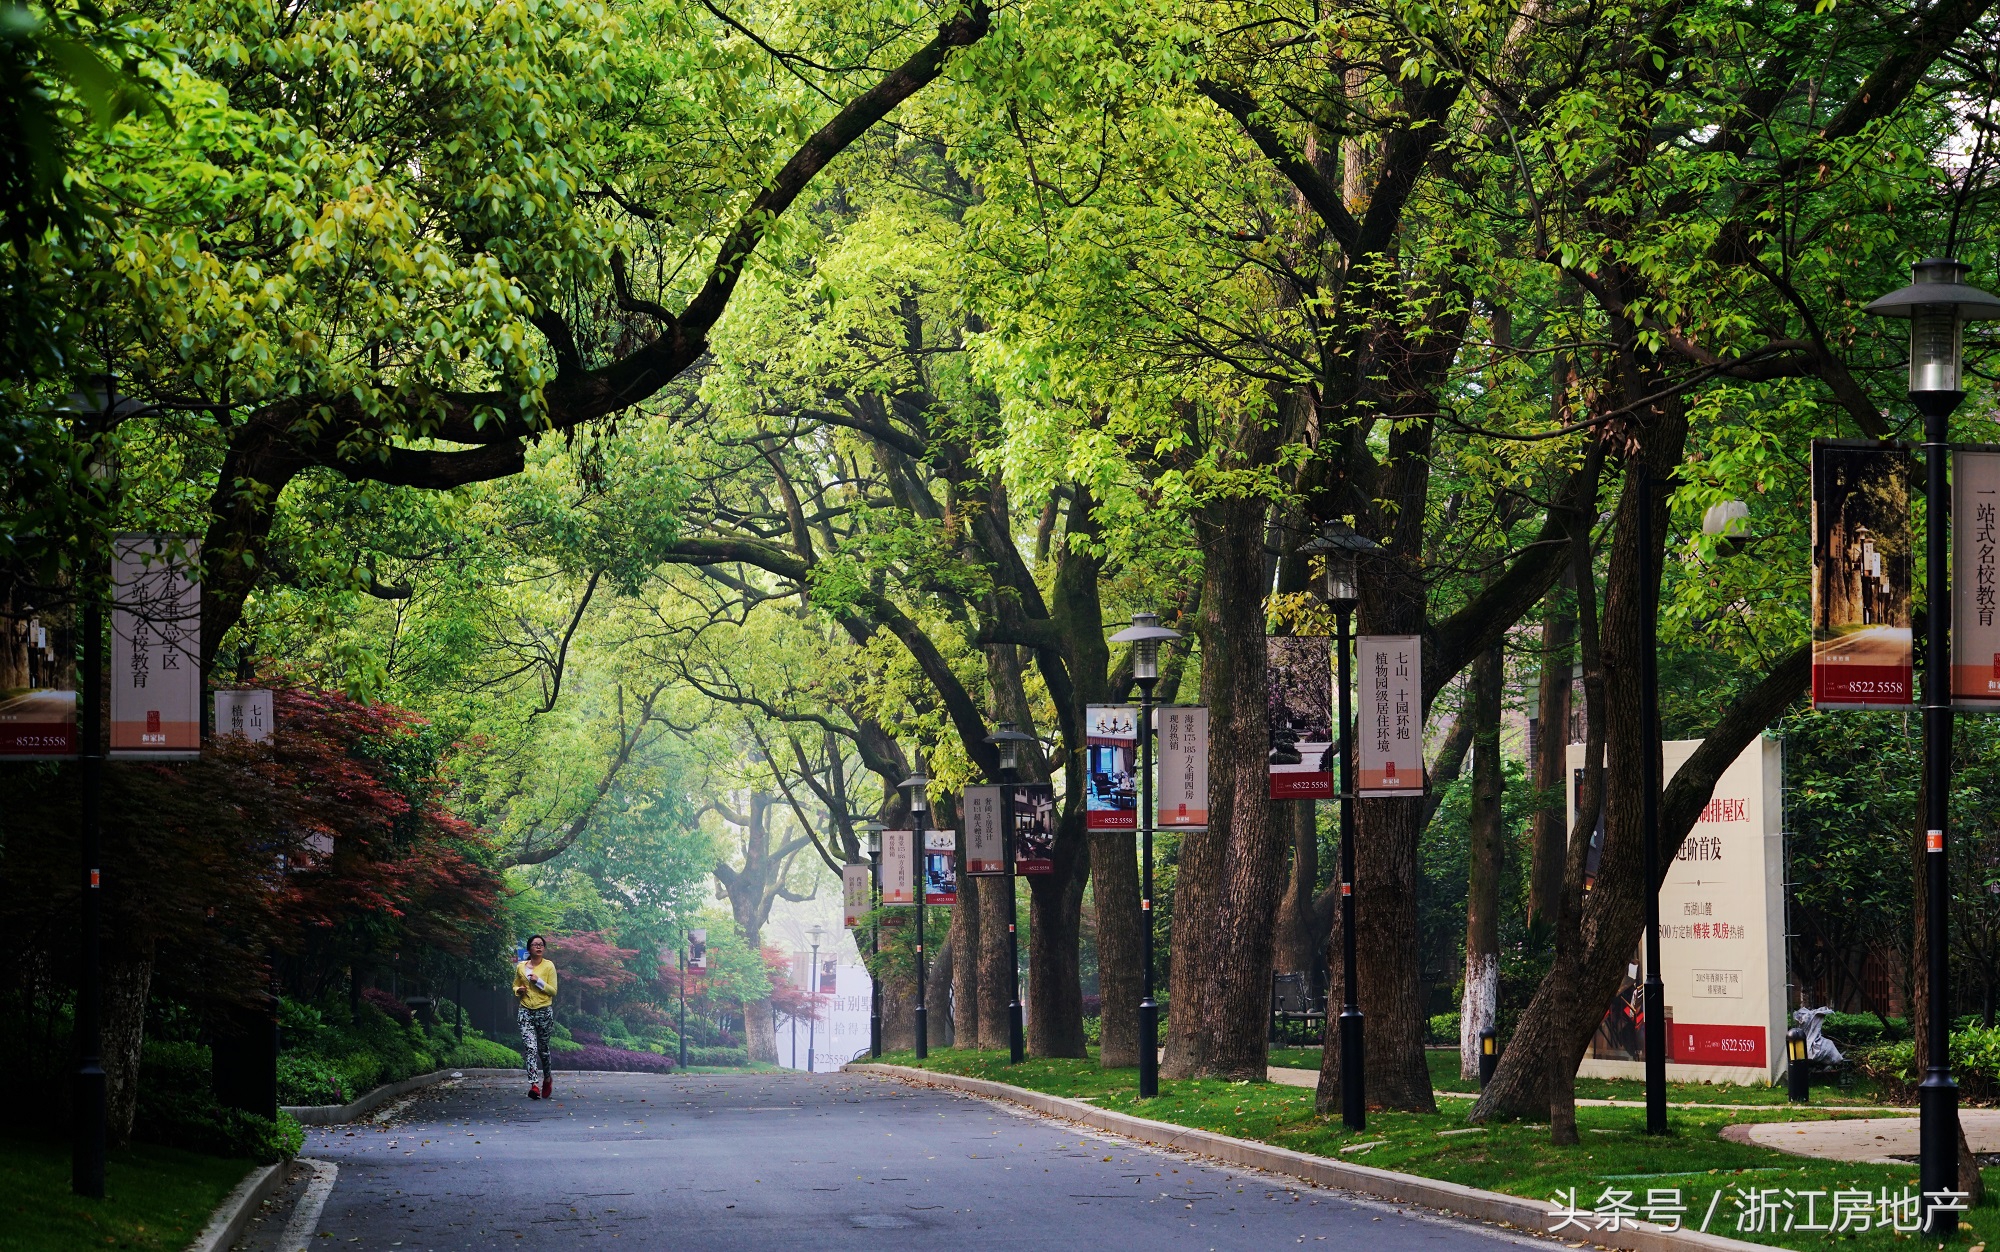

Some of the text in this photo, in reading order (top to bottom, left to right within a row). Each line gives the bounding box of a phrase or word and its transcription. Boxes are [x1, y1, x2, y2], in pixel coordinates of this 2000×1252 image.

[1976, 489, 1996, 626] 一站式名校教育
[1395, 651, 1410, 740] 七山、十园环抱
[1849, 681, 1875, 693] 8522
[1877, 681, 1903, 693] 5558
[1375, 651, 1390, 753] 植物园级居住环境
[16, 736, 40, 747] 8522
[42, 736, 66, 747] 5558
[142, 734, 167, 743] 和家园
[1169, 714, 1179, 751] 现房热销
[1292, 781, 1310, 789] 8522
[1311, 781, 1328, 789] 5558
[1695, 797, 1750, 824] 制排屋区』
[1675, 836, 1722, 861] 进阶首发
[1683, 902, 1713, 916] 西湖山麓
[1712, 921, 1745, 940] 现房热销
[1721, 1038, 1738, 1051] 8522
[1738, 1039, 1755, 1052] 5559
